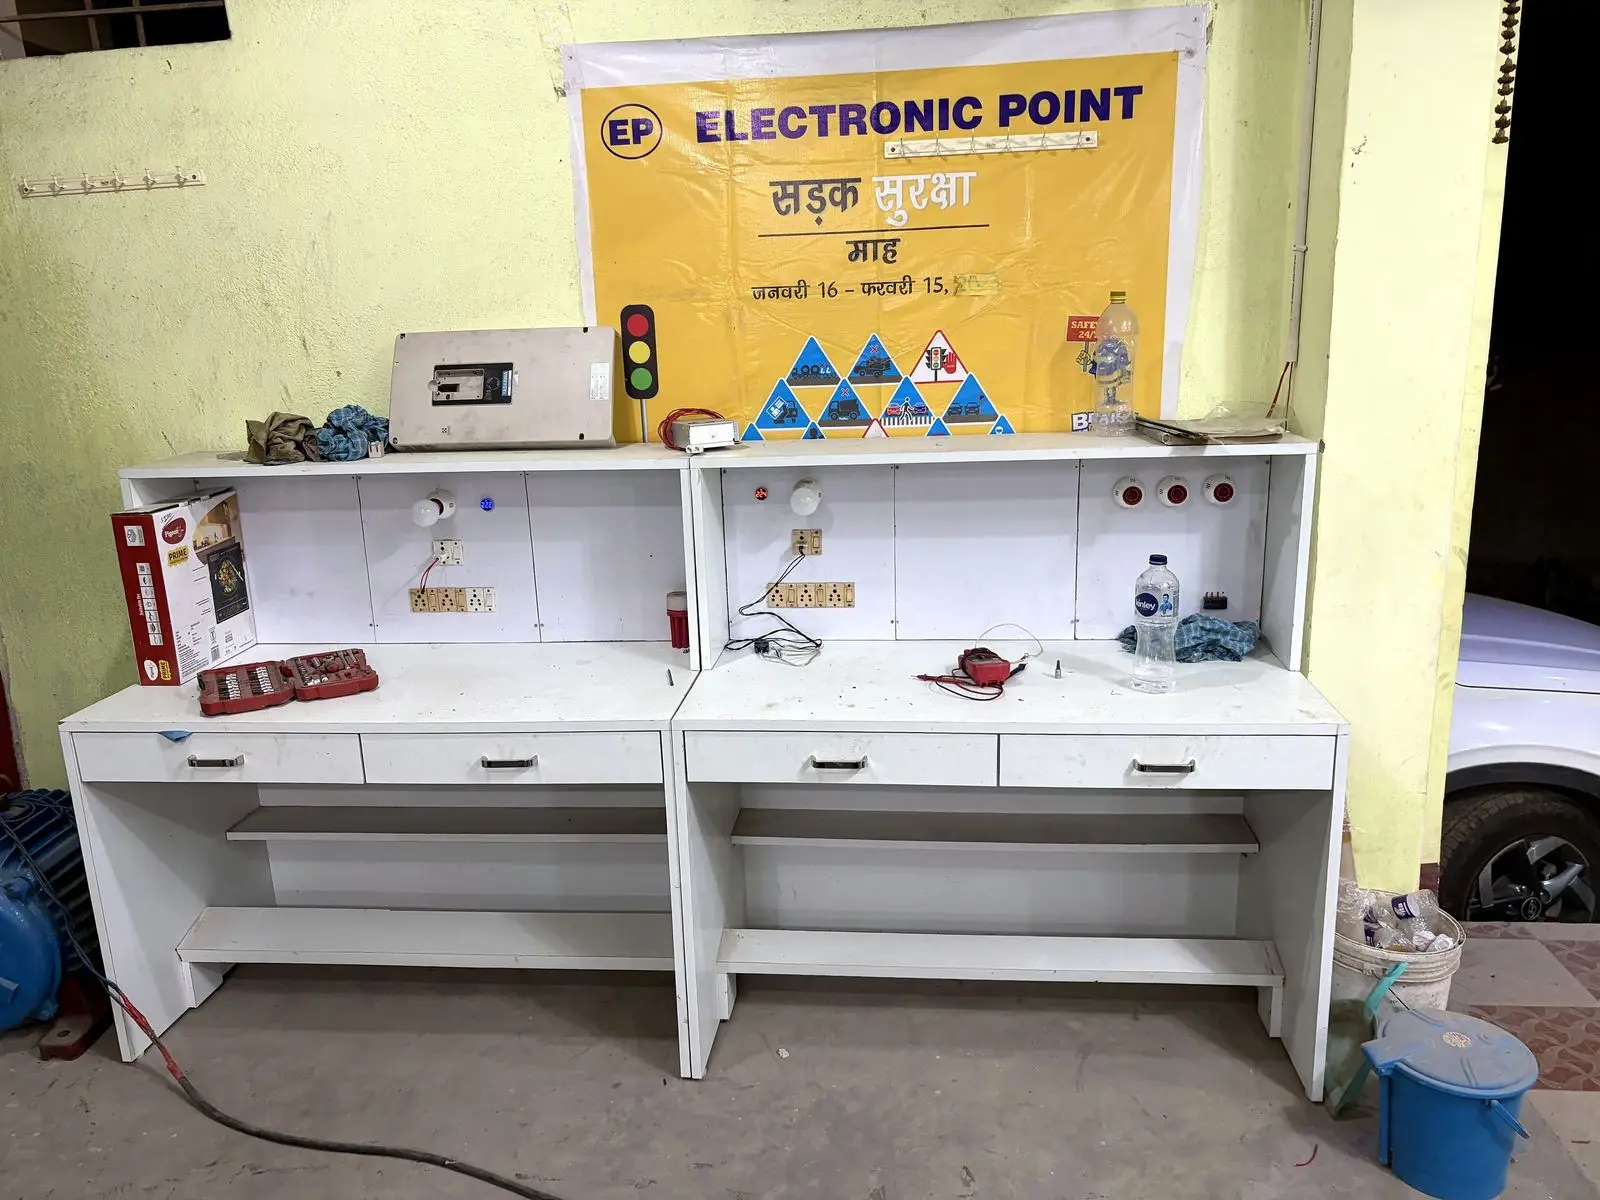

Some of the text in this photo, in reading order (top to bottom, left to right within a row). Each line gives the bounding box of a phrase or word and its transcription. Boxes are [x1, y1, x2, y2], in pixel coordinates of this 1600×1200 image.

[696, 85, 1143, 144] ELECTRONIC POINT
[608, 118, 654, 146] EP
[768, 170, 976, 227] सड़क सुरक्षा
[846, 238, 900, 265] माह
[751, 279, 810, 301] जनवरी
[818, 281, 838, 298] 16
[861, 275, 916, 297] फरवरी
[923, 276, 949, 297] 15,
[1071, 320, 1098, 329] SAFE
[168, 548, 188, 561] PRIME
